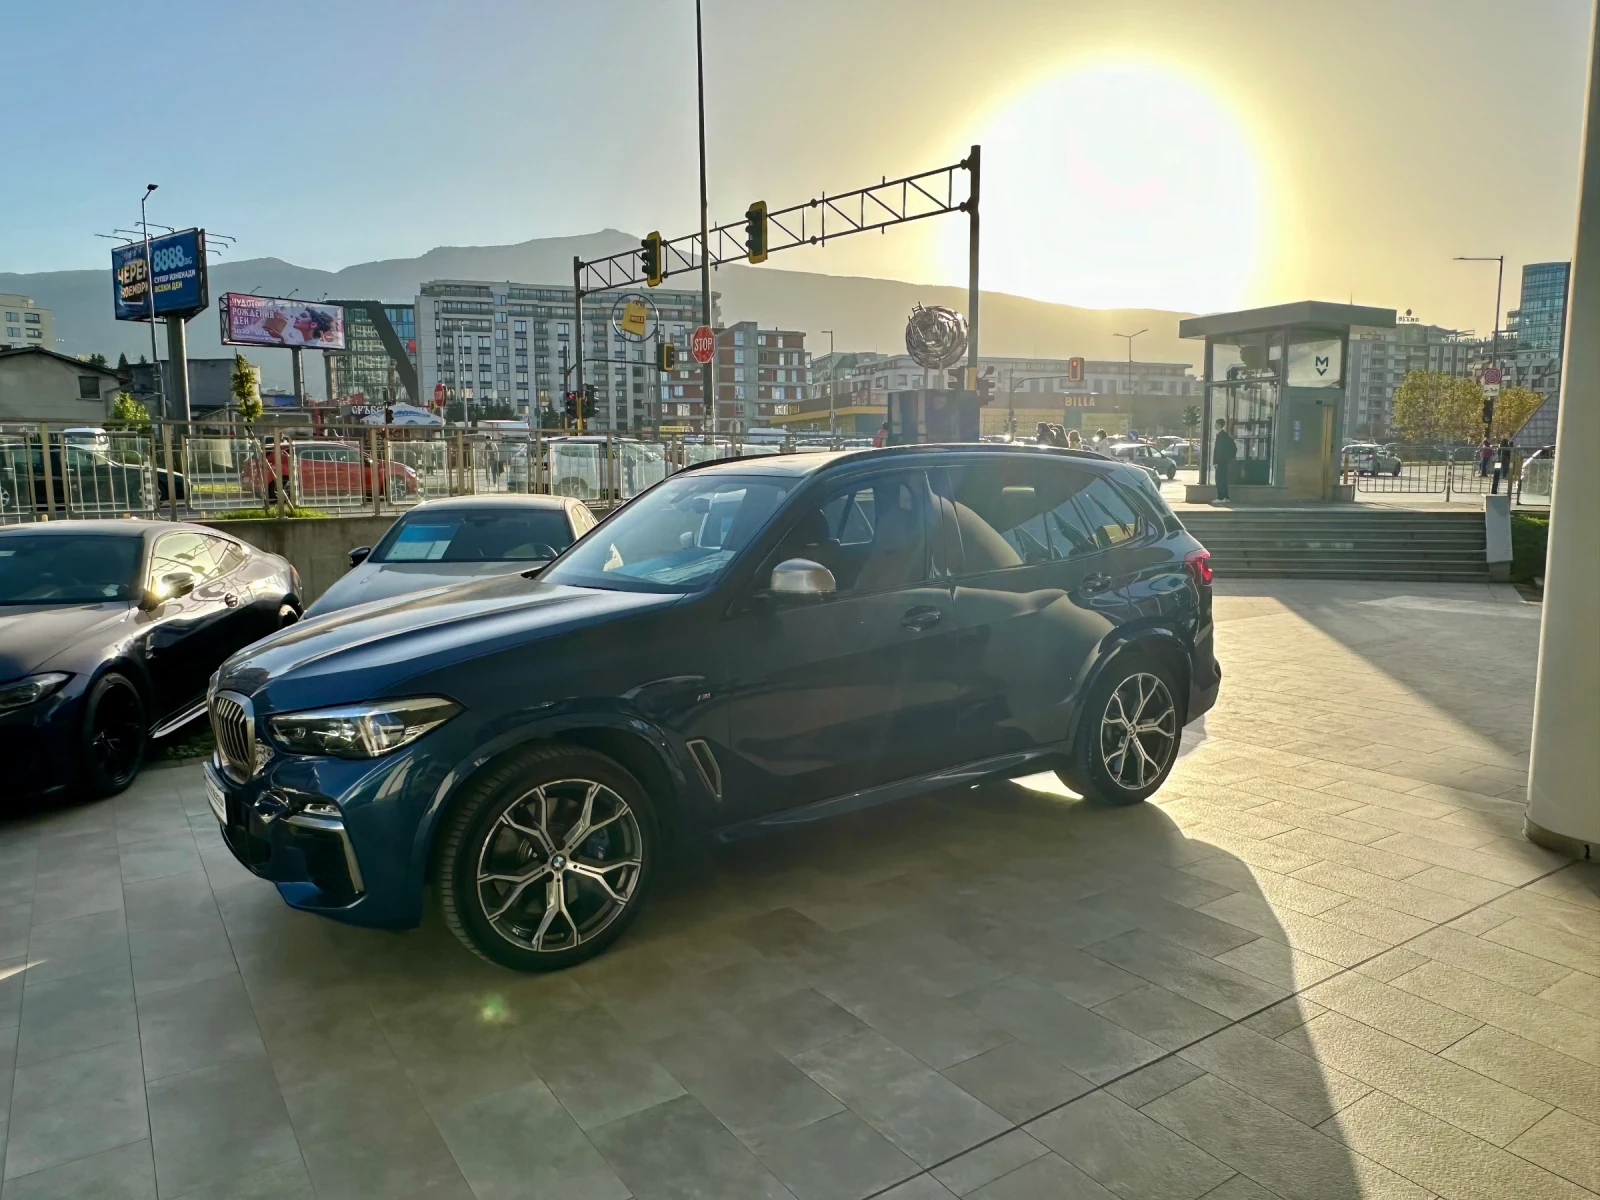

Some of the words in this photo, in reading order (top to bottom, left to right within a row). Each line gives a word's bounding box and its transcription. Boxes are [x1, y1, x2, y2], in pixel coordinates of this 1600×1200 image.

[172, 281, 183, 291] ДЕН
[232, 308, 275, 320] РОЖДЕНИЯ
[233, 317, 249, 326] ДЕН
[695, 337, 712, 351] STOP
[1065, 396, 1095, 406] BILLA
